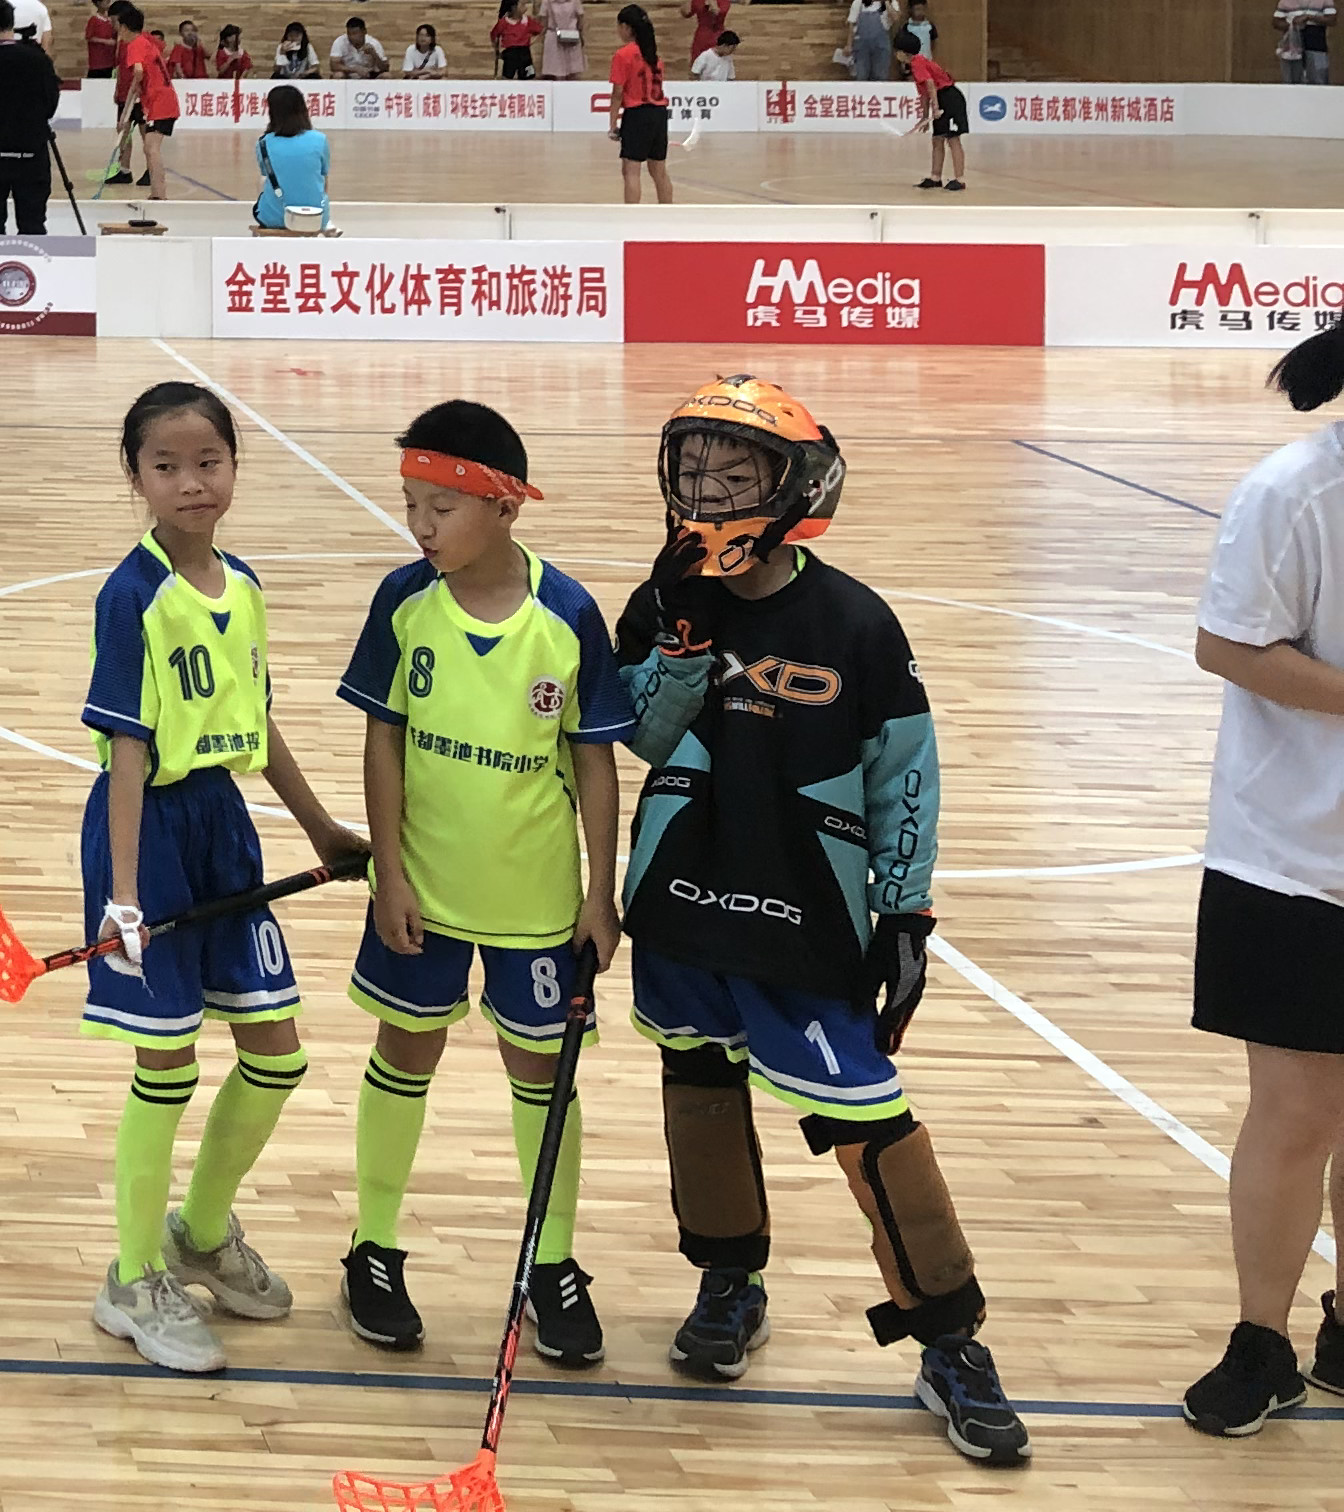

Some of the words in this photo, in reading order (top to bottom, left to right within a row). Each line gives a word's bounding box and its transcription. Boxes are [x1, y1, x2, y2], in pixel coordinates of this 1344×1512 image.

[223, 259, 609, 320] 金堂县文化体育和旅游局
[746, 258, 921, 305] HMedia
[746, 306, 921, 329] 虎马传媒
[168, 644, 215, 701] 10
[408, 646, 436, 698] 8
[668, 877, 803, 926] OXDOG
[250, 920, 285, 979] 10
[529, 956, 561, 1009] 8
[803, 1019, 841, 1076] 1
